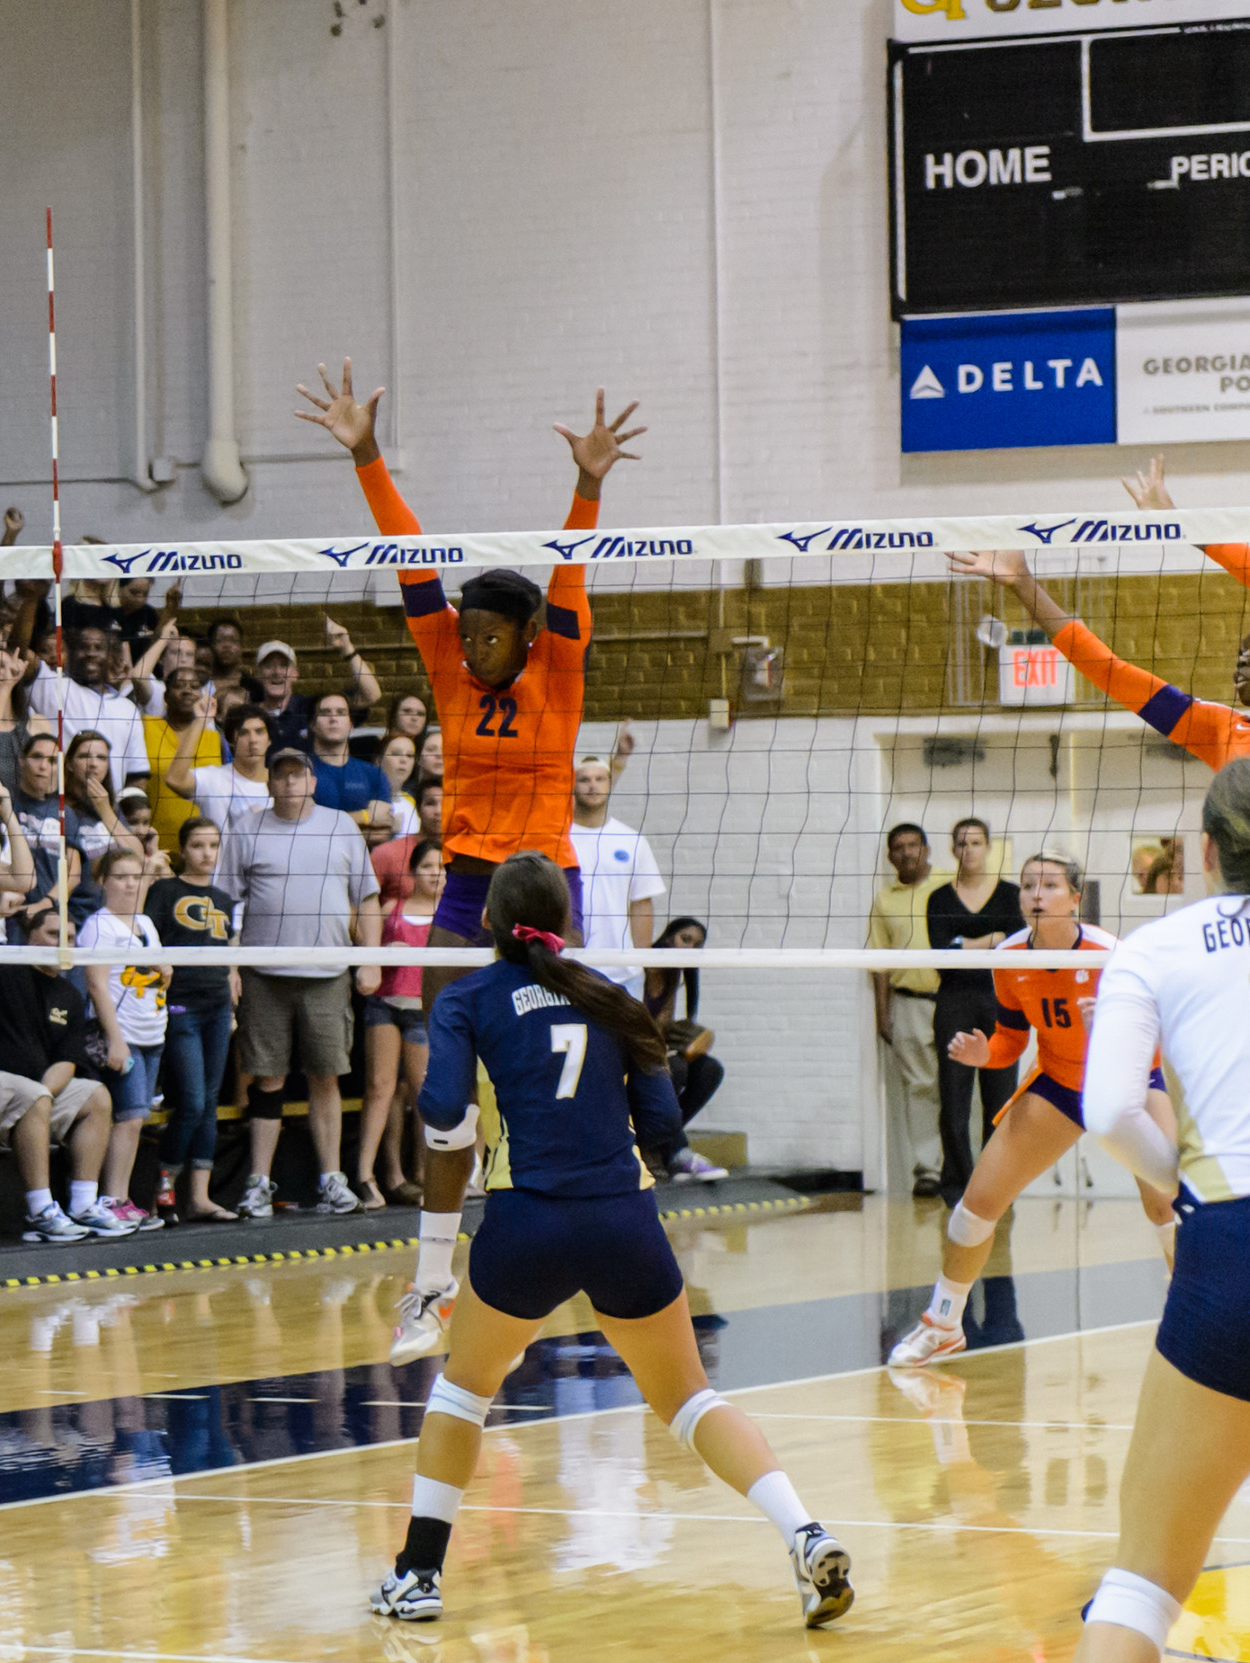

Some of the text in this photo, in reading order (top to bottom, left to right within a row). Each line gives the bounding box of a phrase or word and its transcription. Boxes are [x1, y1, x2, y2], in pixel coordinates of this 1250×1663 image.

[924, 146, 1052, 190] HOME
[957, 357, 1104, 394] DELTA
[146, 519, 1181, 572] MIZUNO MIZUNO MIZUNO MIZUNO MIZUNO
[1013, 649, 1059, 688] EXIT
[475, 694, 519, 738] 22
[174, 895, 231, 941] GT
[1202, 917, 1250, 954] GEO
[1041, 998, 1073, 1029] 15
[550, 1023, 588, 1100] 7
